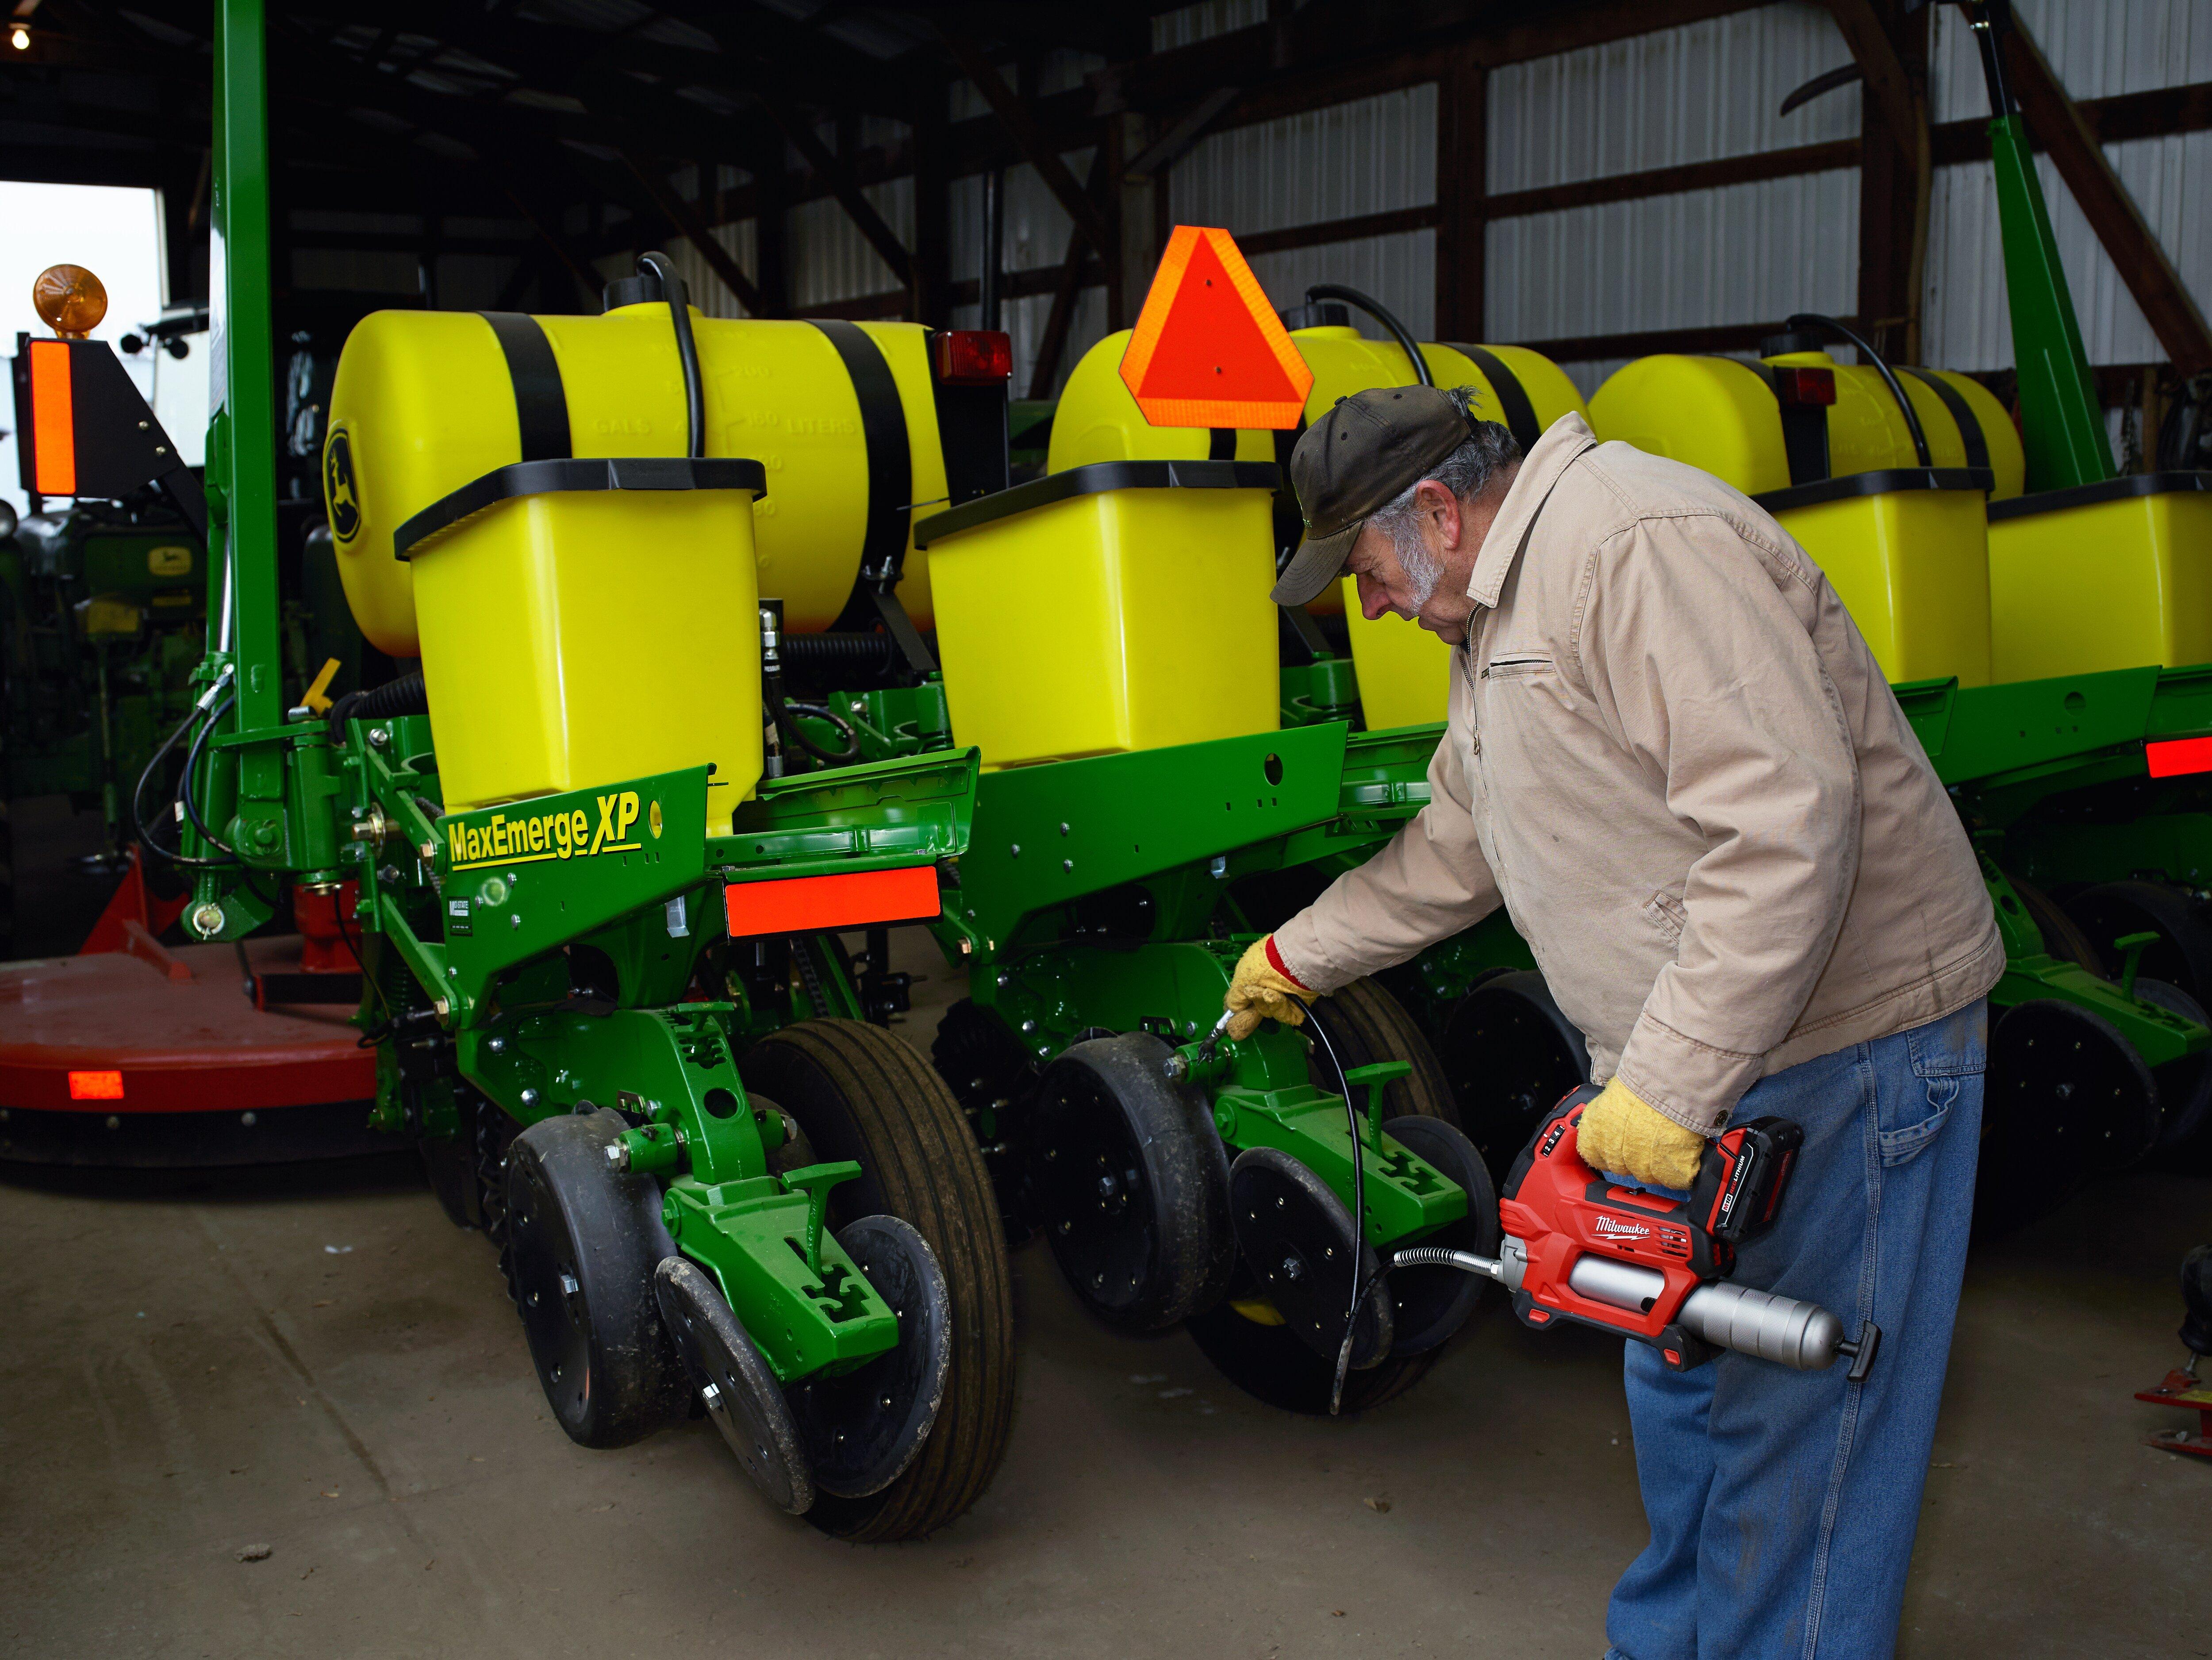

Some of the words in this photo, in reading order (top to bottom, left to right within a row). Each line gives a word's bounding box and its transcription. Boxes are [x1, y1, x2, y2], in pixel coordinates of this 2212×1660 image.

[592, 418, 653, 435] GALS
[787, 418, 856, 435] LITERS
[448, 809, 589, 862] MaxEmerge
[589, 791, 640, 855] XP
[1723, 1195, 1732, 1211] M18
[1729, 1155, 1745, 1194] REDLITHIUM
[1595, 1215, 1650, 1235] Milwaukee
